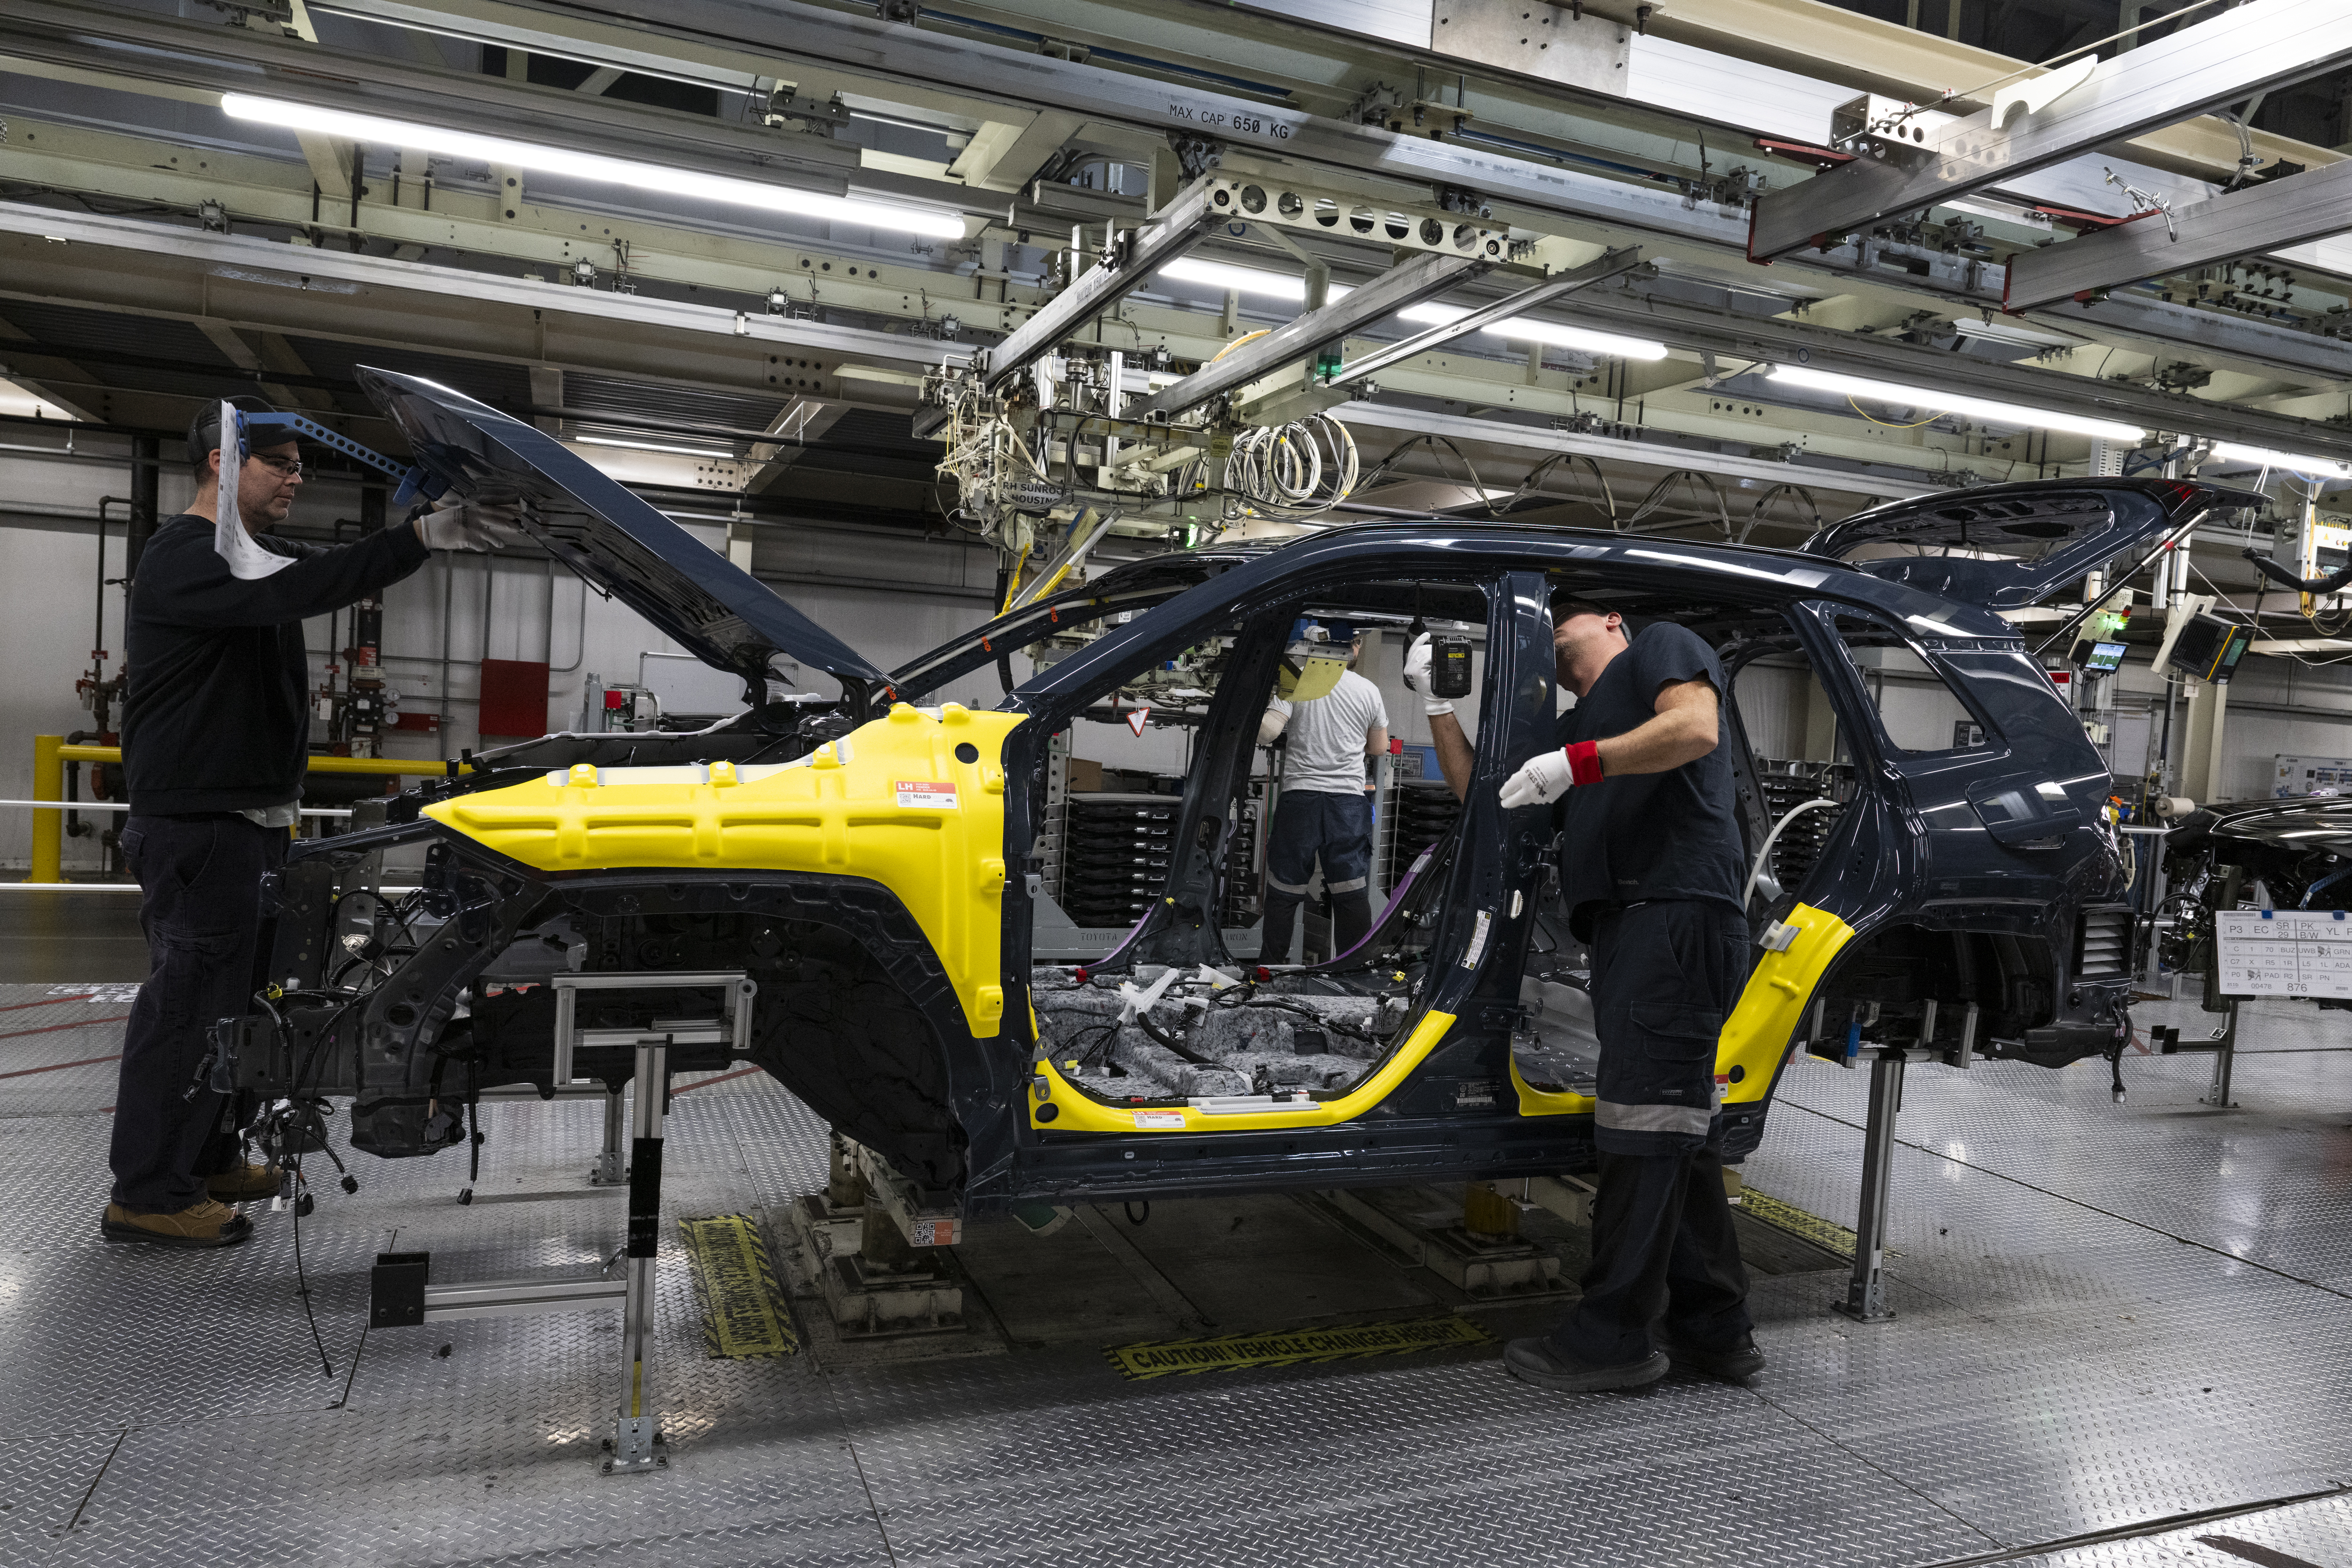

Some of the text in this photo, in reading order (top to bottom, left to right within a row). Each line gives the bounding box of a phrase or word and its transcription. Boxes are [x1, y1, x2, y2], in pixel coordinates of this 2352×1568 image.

[1169, 104, 1288, 139] MAX CAP 650 KG
[1003, 482, 1017, 490] RH
[2287, 983, 2307, 992] 876
[1132, 1323, 1465, 1368] CAUTION! VEHICLE CHANGES HEIGHT
